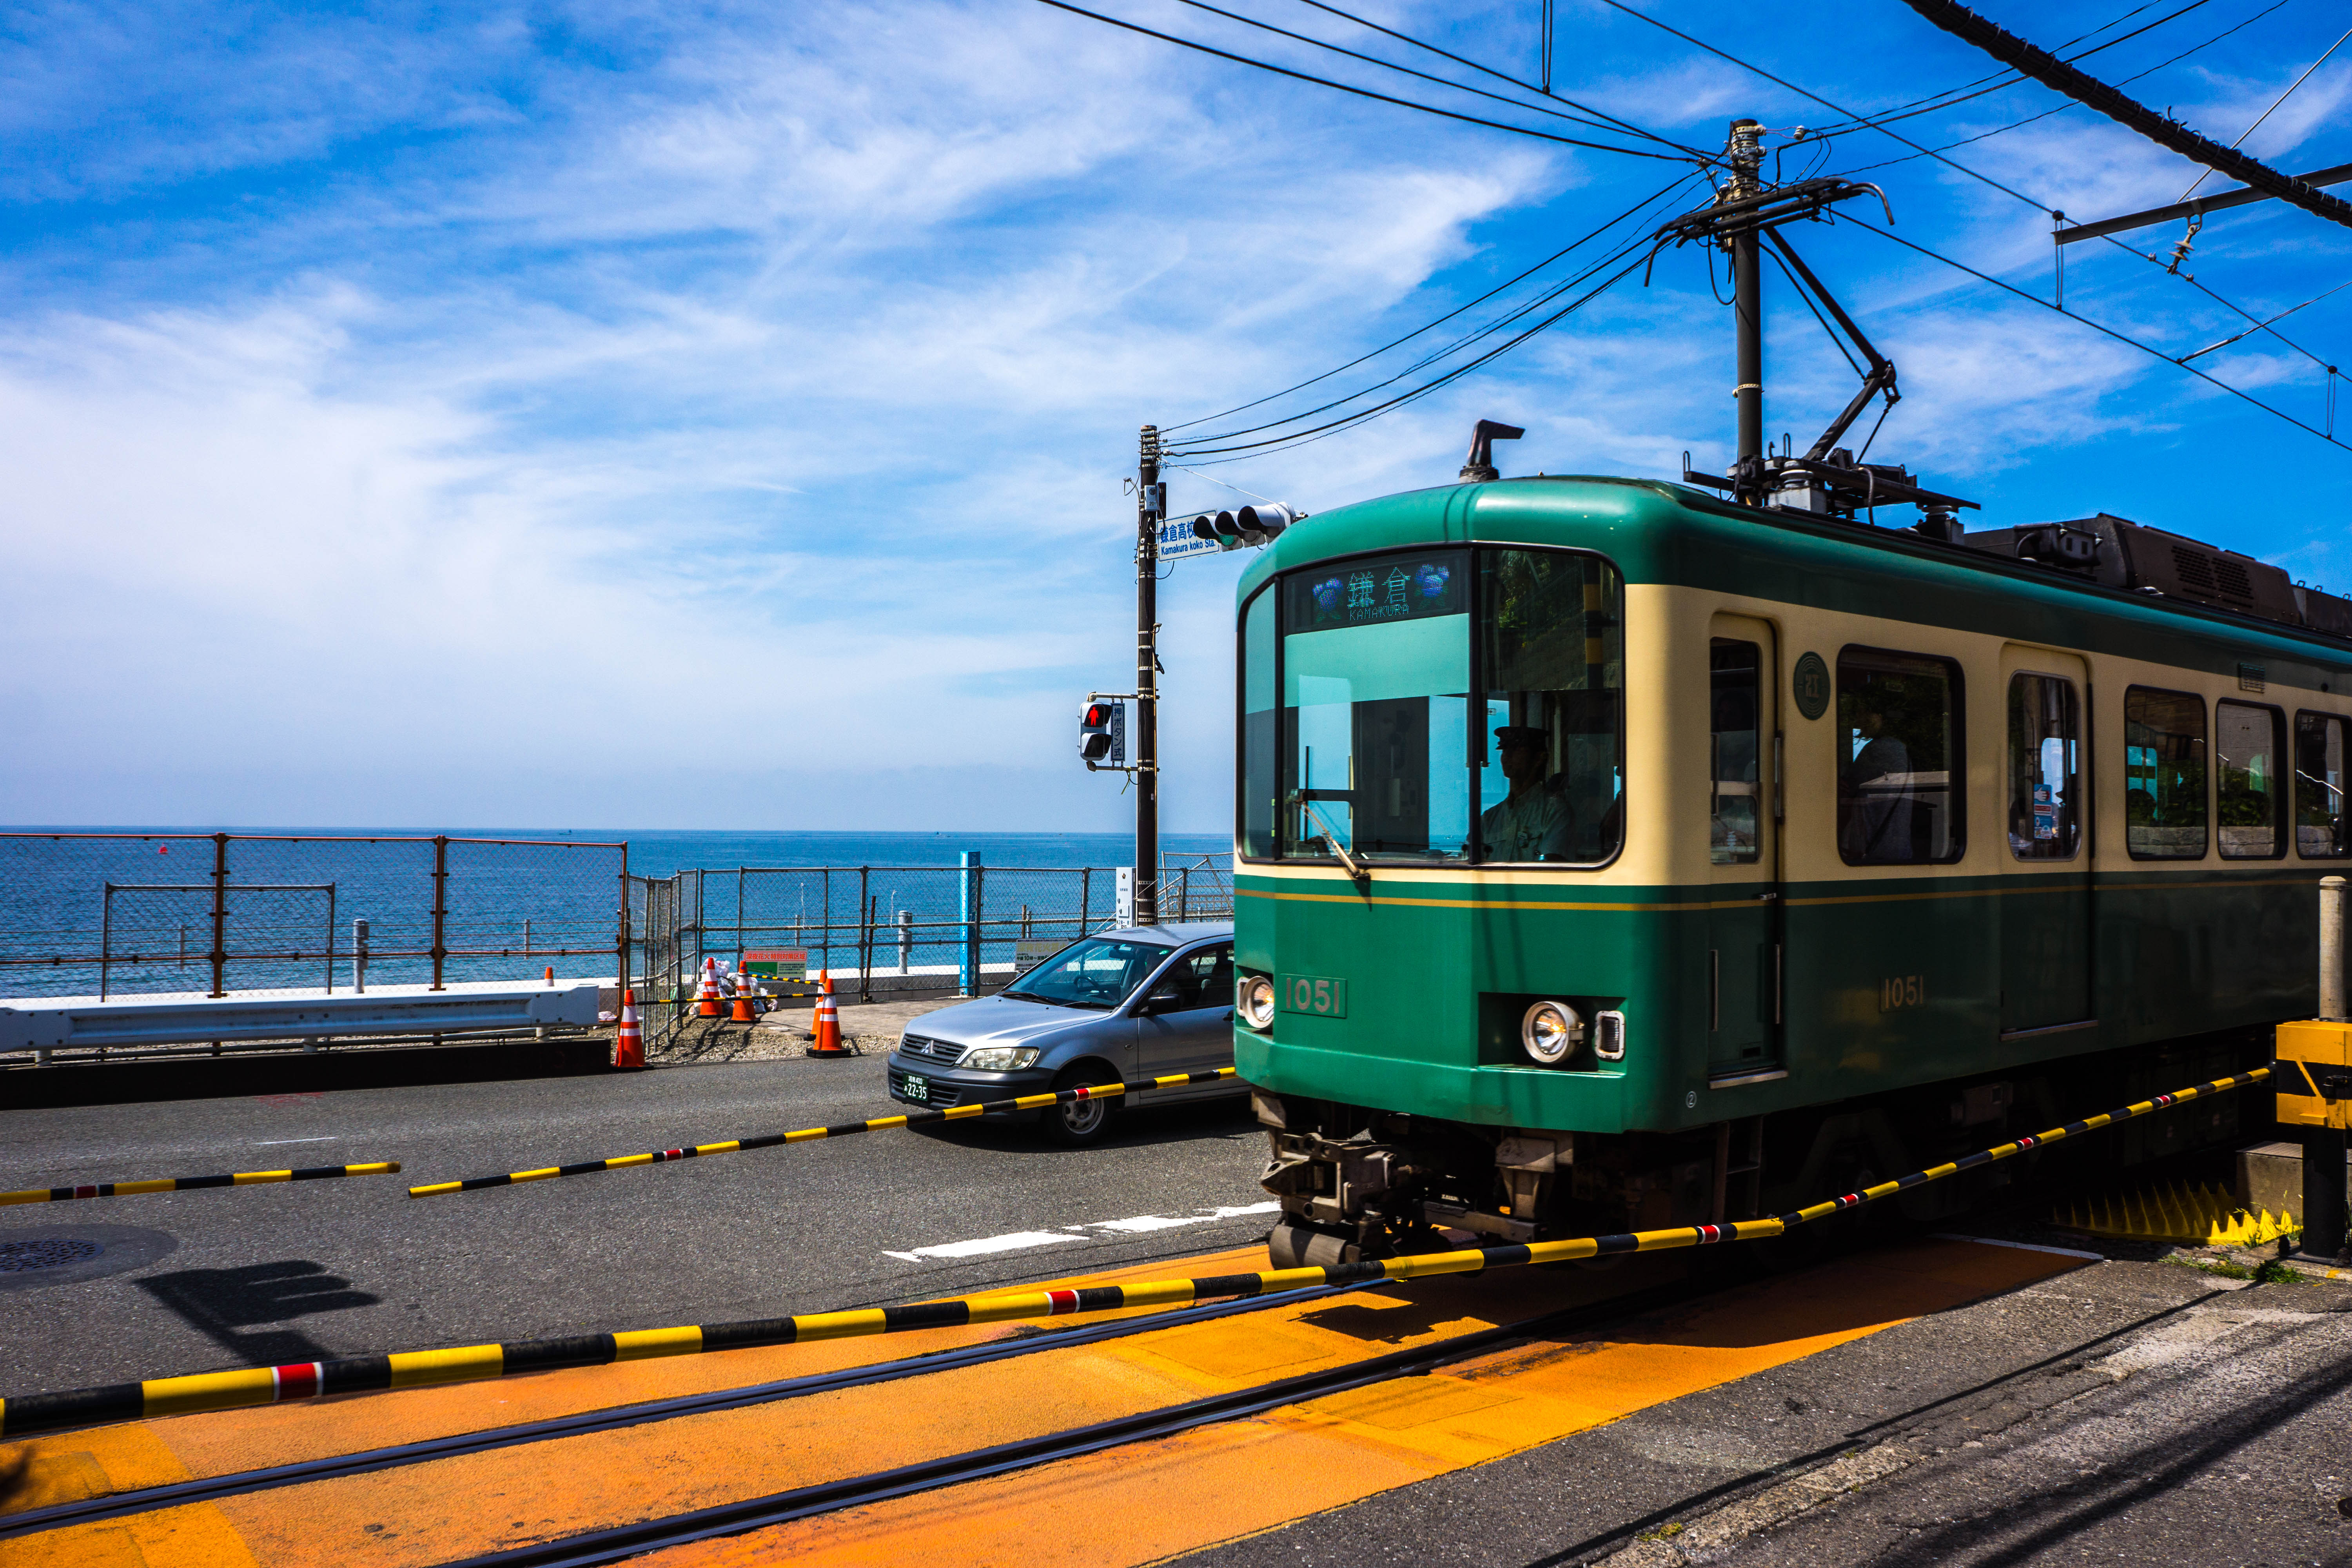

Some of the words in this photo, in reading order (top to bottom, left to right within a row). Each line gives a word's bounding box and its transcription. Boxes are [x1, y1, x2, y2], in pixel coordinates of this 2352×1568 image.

[1161, 544, 1188, 555] Kamakura
[1190, 541, 1203, 551] koko
[1205, 539, 1216, 548] Sta.
[1347, 567, 1411, 608] 鎌倉
[1350, 603, 1409, 621] KAMAKURA
[1286, 977, 1339, 1014] 1051
[1885, 975, 1923, 1009] 1051
